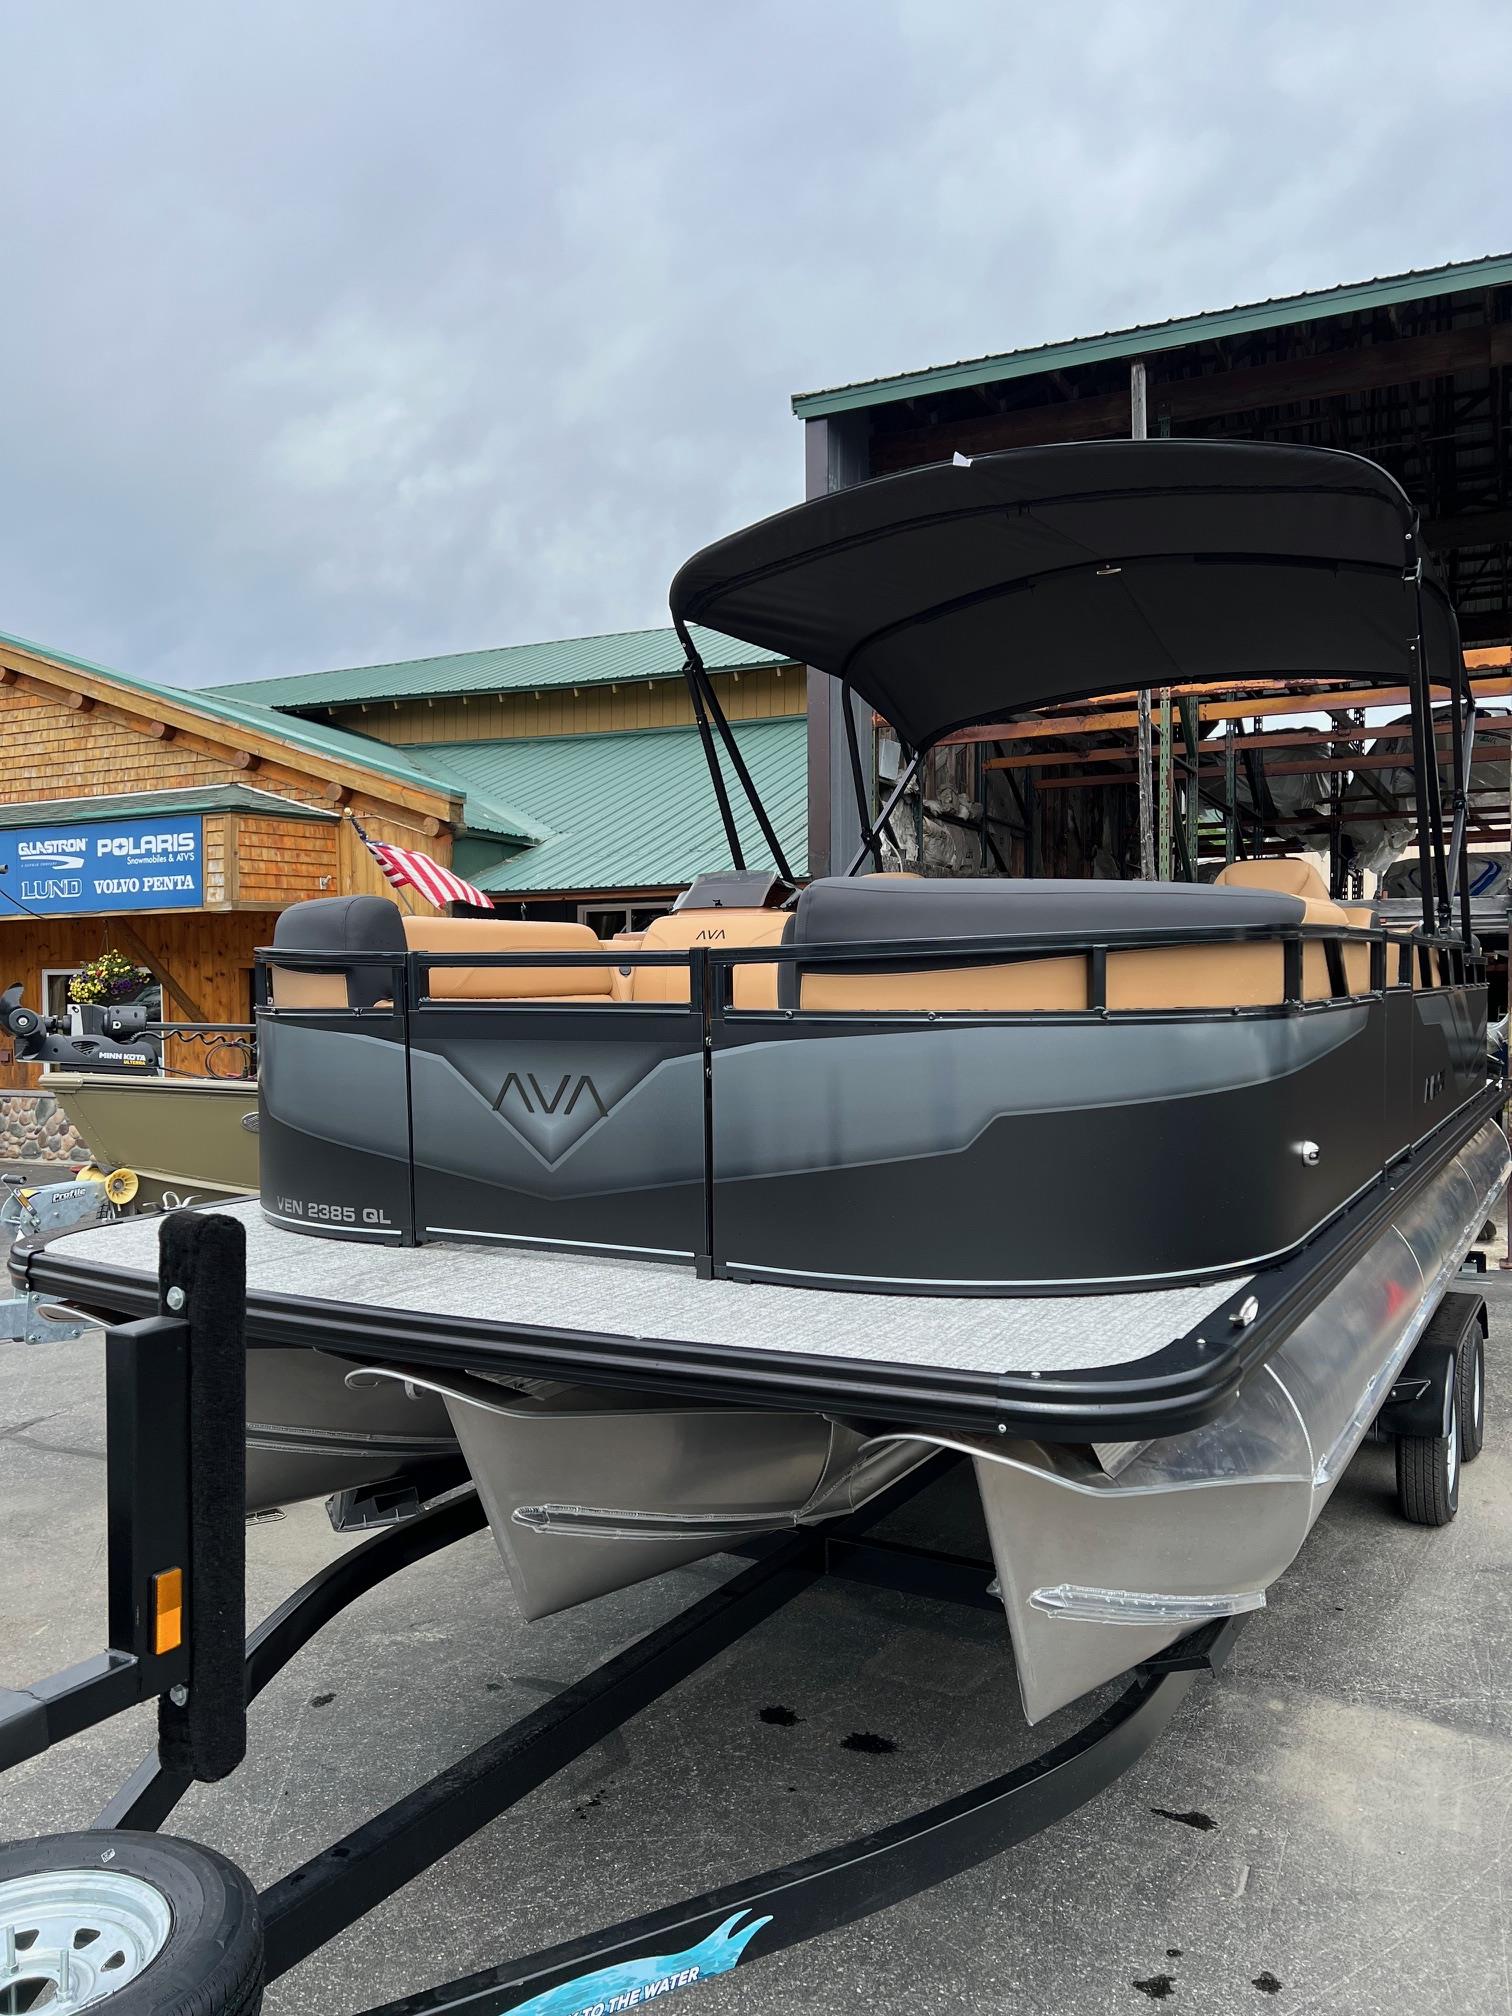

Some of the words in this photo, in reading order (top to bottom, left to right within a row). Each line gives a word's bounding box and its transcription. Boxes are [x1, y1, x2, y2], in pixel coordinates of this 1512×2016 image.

[18, 838, 86, 855] GLASTRON
[97, 832, 194, 857] POLARIS
[127, 853, 167, 865] Snowmobiles
[168, 853, 175, 863] &
[21, 878, 82, 900] LUND
[93, 877, 140, 895] VOLVO
[142, 874, 195, 892] PENTA
[98, 1051, 123, 1060] MINN
[123, 1053, 146, 1062] KOTA
[276, 1195, 303, 1215] VEN
[307, 1202, 356, 1223] 2385
[362, 1207, 392, 1225] QL
[580, 2001, 606, 2016] TO
[607, 1988, 642, 2014] THE
[643, 1965, 701, 2000] WATER
